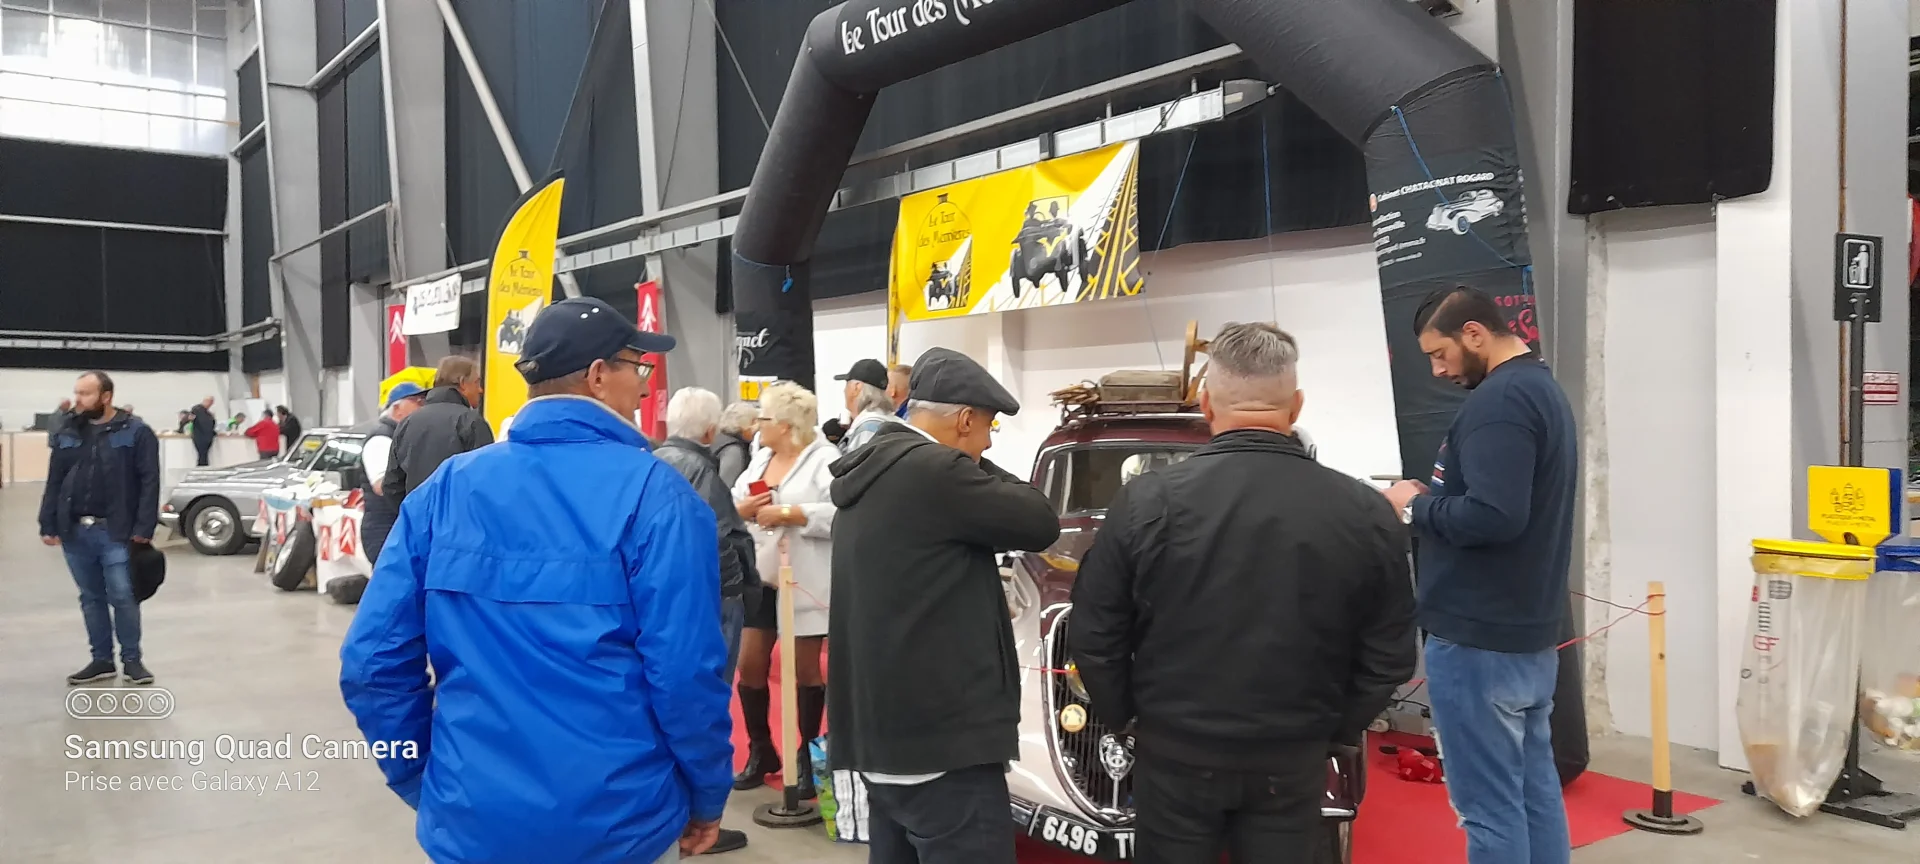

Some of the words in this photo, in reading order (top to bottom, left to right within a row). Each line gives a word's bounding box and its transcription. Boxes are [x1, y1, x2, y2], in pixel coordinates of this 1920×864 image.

[841, 20, 865, 55] Le
[866, 7, 908, 44] Tour
[911, 0, 948, 27] des
[1042, 816, 1099, 856] 6496
